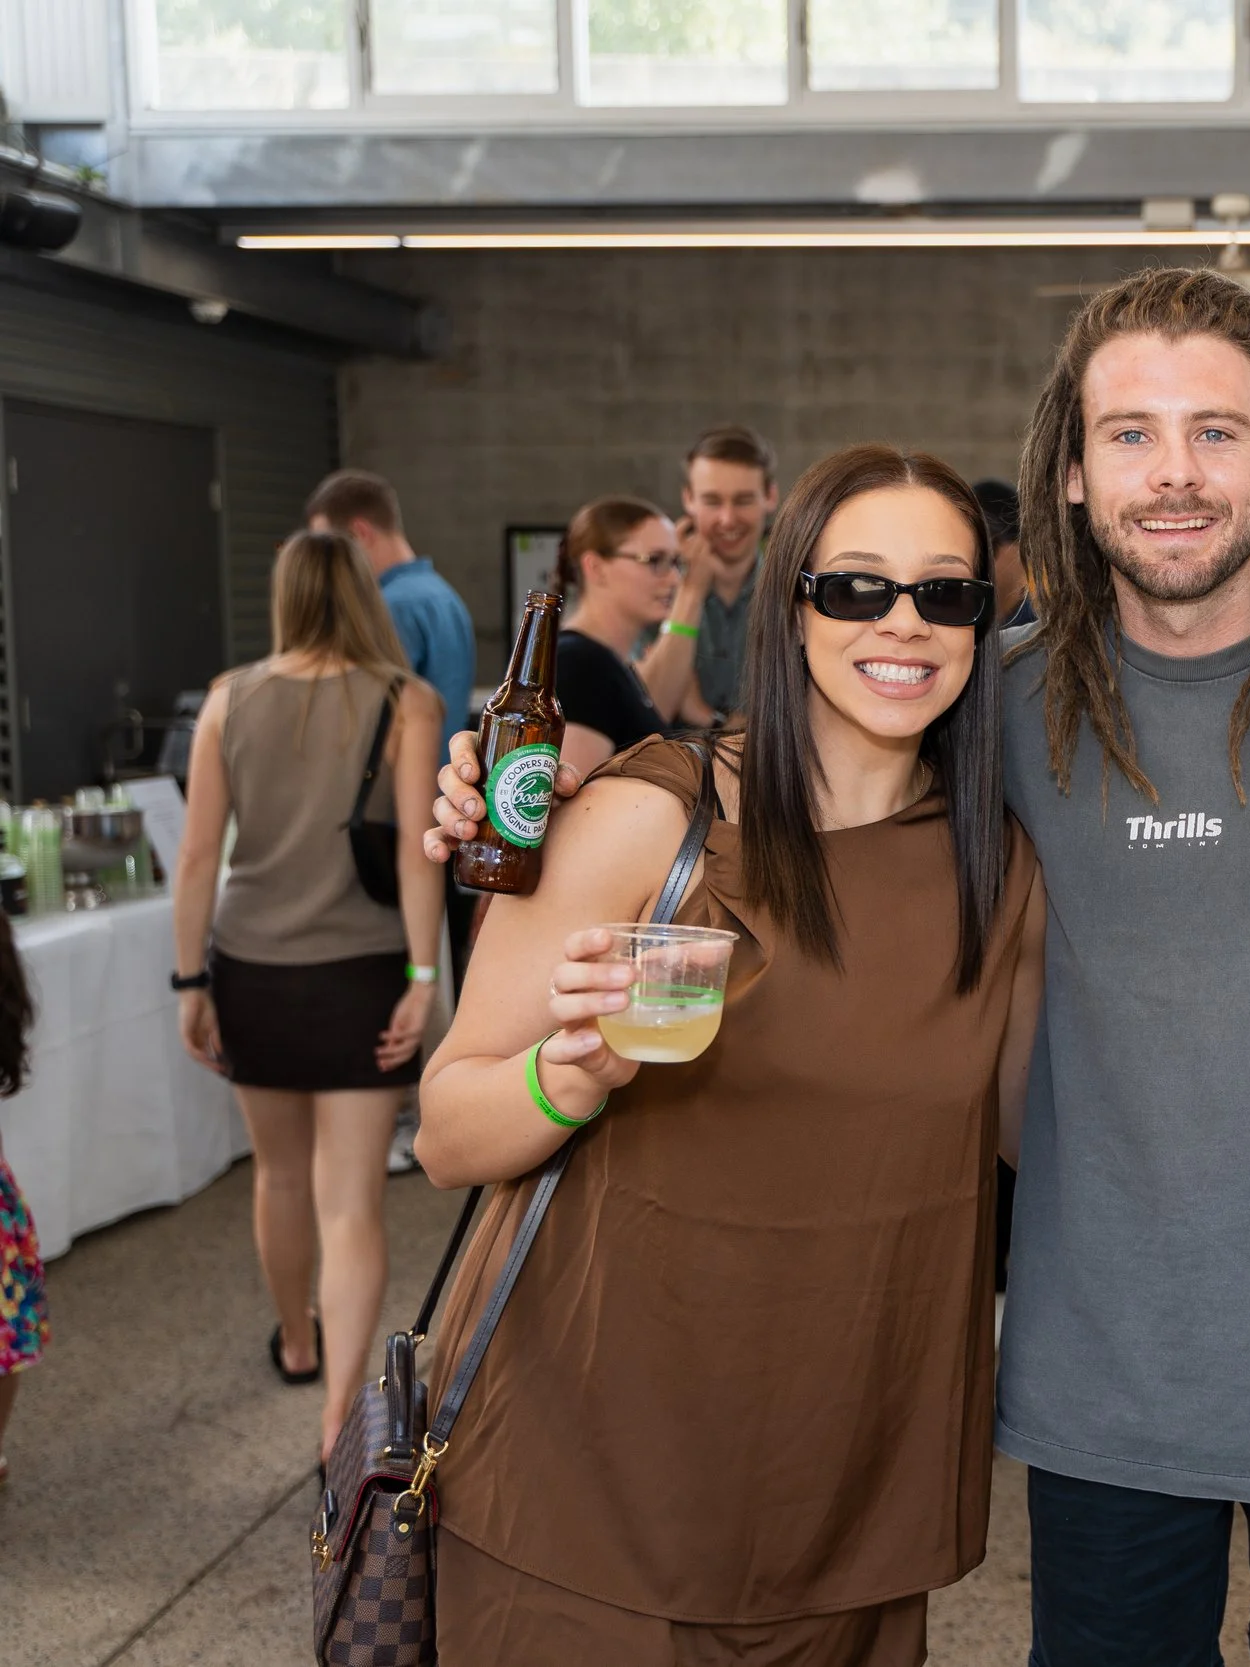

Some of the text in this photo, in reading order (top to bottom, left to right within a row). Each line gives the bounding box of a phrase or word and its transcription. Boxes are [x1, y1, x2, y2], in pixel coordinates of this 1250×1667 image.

[504, 759, 542, 786] COOPERS
[501, 801, 531, 834] ORIGINAL
[1126, 812, 1222, 840] Thrills
